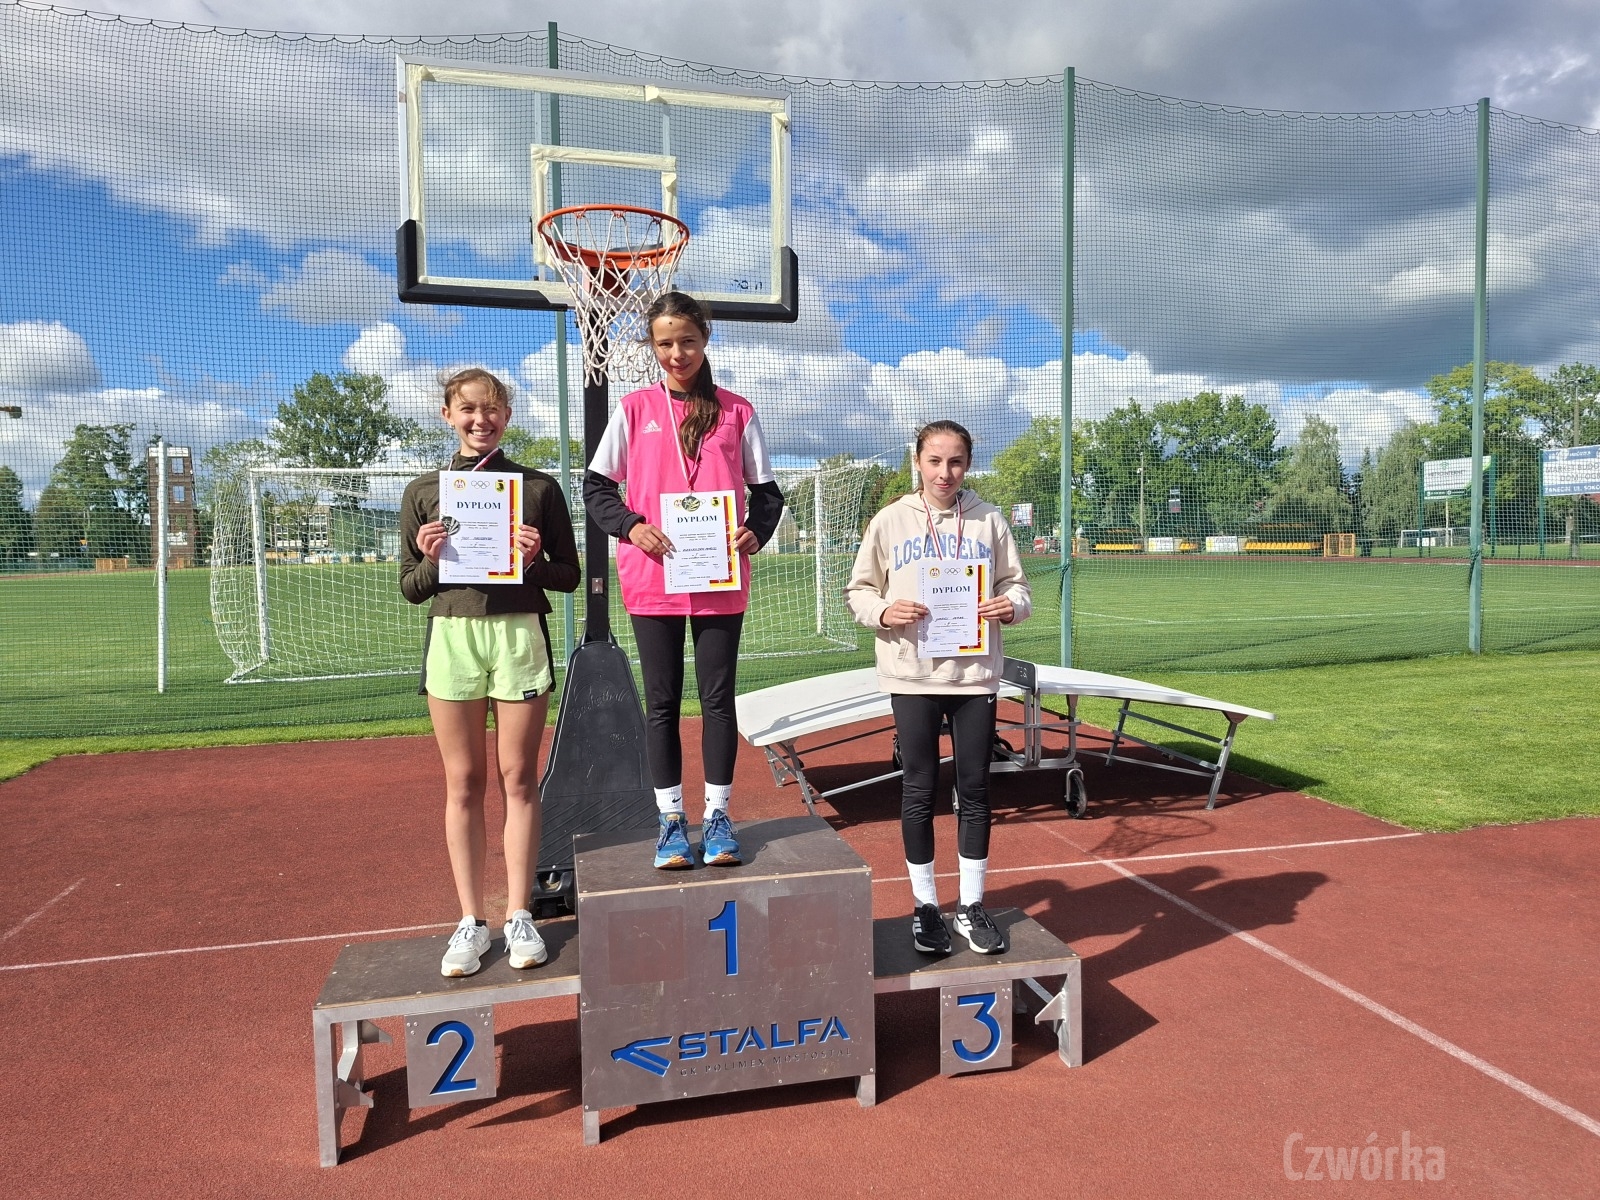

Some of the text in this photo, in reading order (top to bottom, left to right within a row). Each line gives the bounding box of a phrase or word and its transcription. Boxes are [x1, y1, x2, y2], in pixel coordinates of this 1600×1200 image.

[456, 501, 501, 510] DYPLOM
[677, 514, 718, 524] DYPLOM
[893, 535, 922, 571] LOS
[932, 585, 971, 594] DYPLOM
[708, 900, 738, 976] 1
[678, 1016, 850, 1060] STALFA
[952, 992, 1002, 1063] 3
[426, 1020, 477, 1096] 2
[680, 1048, 852, 1077] GK POLIMEX MOSTOSTAL
